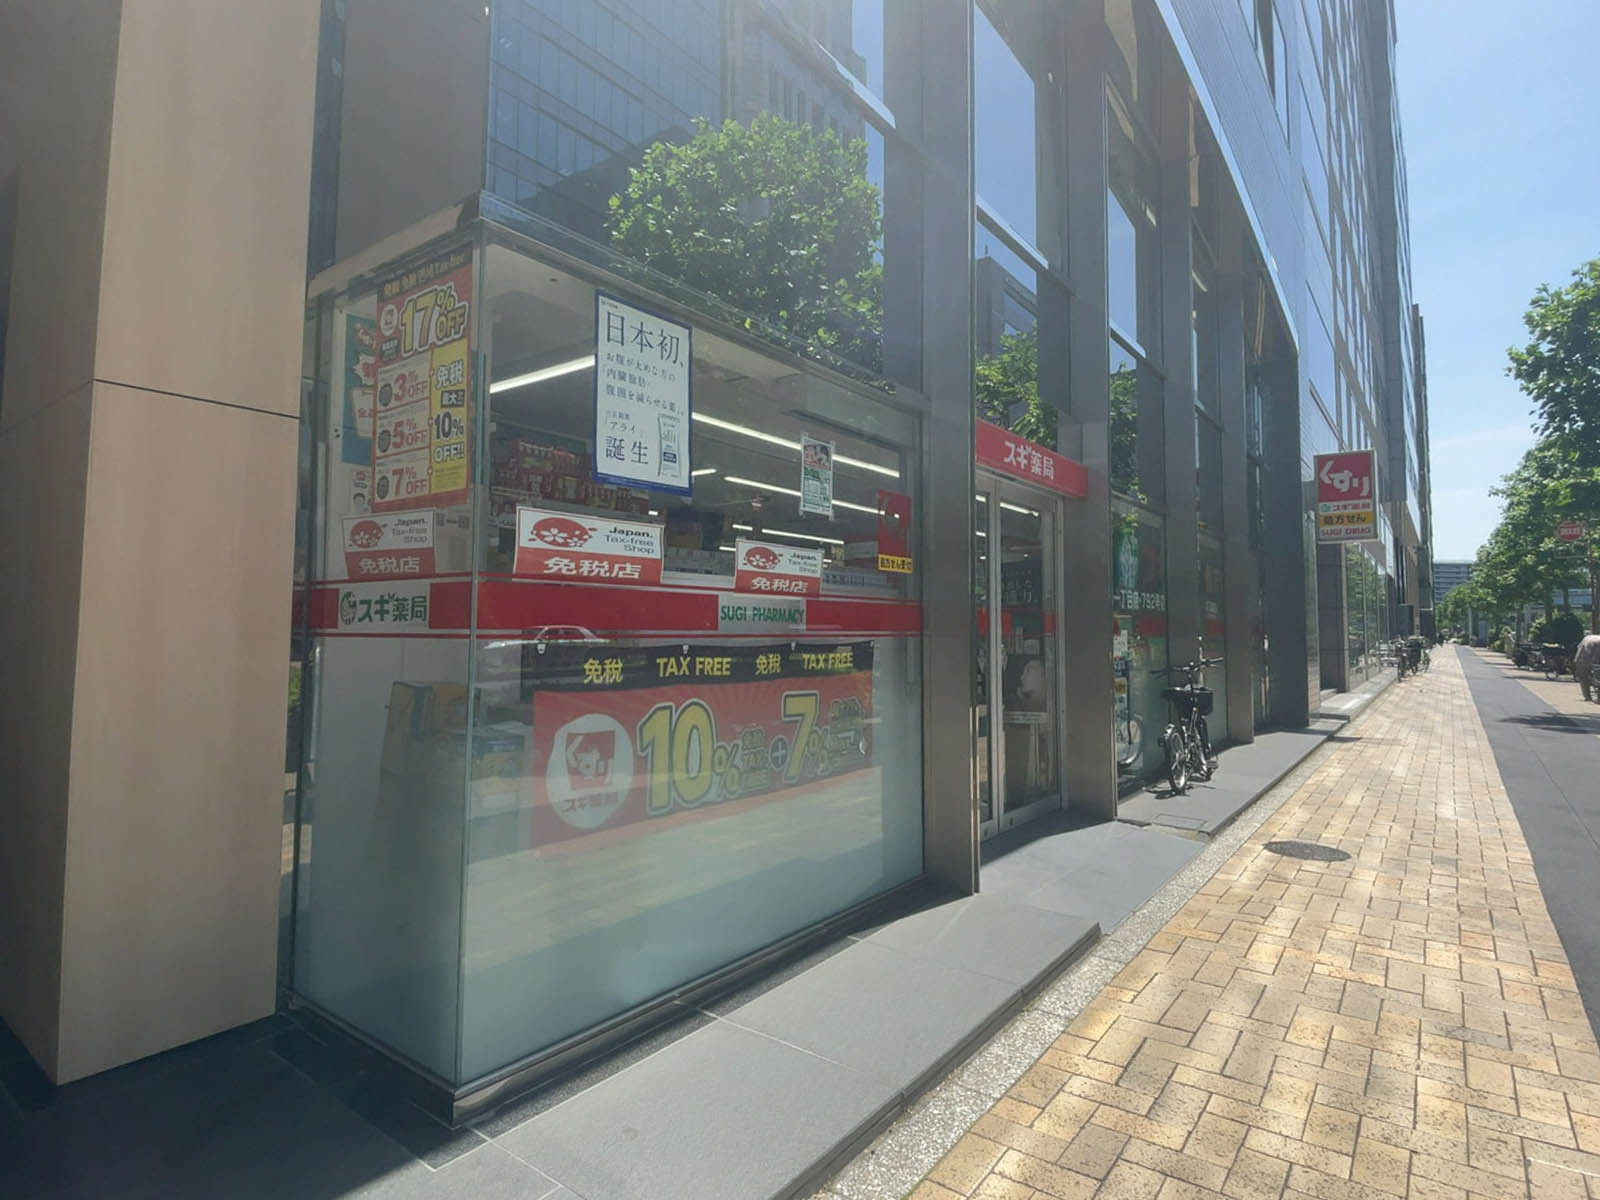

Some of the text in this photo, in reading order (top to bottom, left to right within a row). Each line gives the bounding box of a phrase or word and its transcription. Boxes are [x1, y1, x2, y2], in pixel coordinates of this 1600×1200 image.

[401, 287, 456, 353] 17%
[436, 305, 466, 339] OFF
[436, 360, 464, 389] 免税
[408, 381, 428, 398] OFF
[406, 430, 428, 446] OFF
[435, 412, 464, 440] 10%
[605, 436, 648, 465] 誕生
[1003, 440, 1055, 481] スギ薬局
[391, 467, 417, 497] 7%
[406, 480, 428, 495] OFF
[1320, 460, 1370, 497] くすり
[604, 535, 654, 547] Tax-free
[609, 527, 653, 539] Japan.
[624, 545, 655, 554] Shop
[359, 556, 421, 575] 免税店
[544, 556, 642, 580] 免税店
[752, 576, 809, 593] 免税店
[358, 592, 428, 623] スギ薬局
[720, 605, 805, 624] SUGI PHARMACY
[584, 651, 854, 684] 免税 TAX FREE 免税 TAX FREE
[639, 701, 740, 810] 10%
